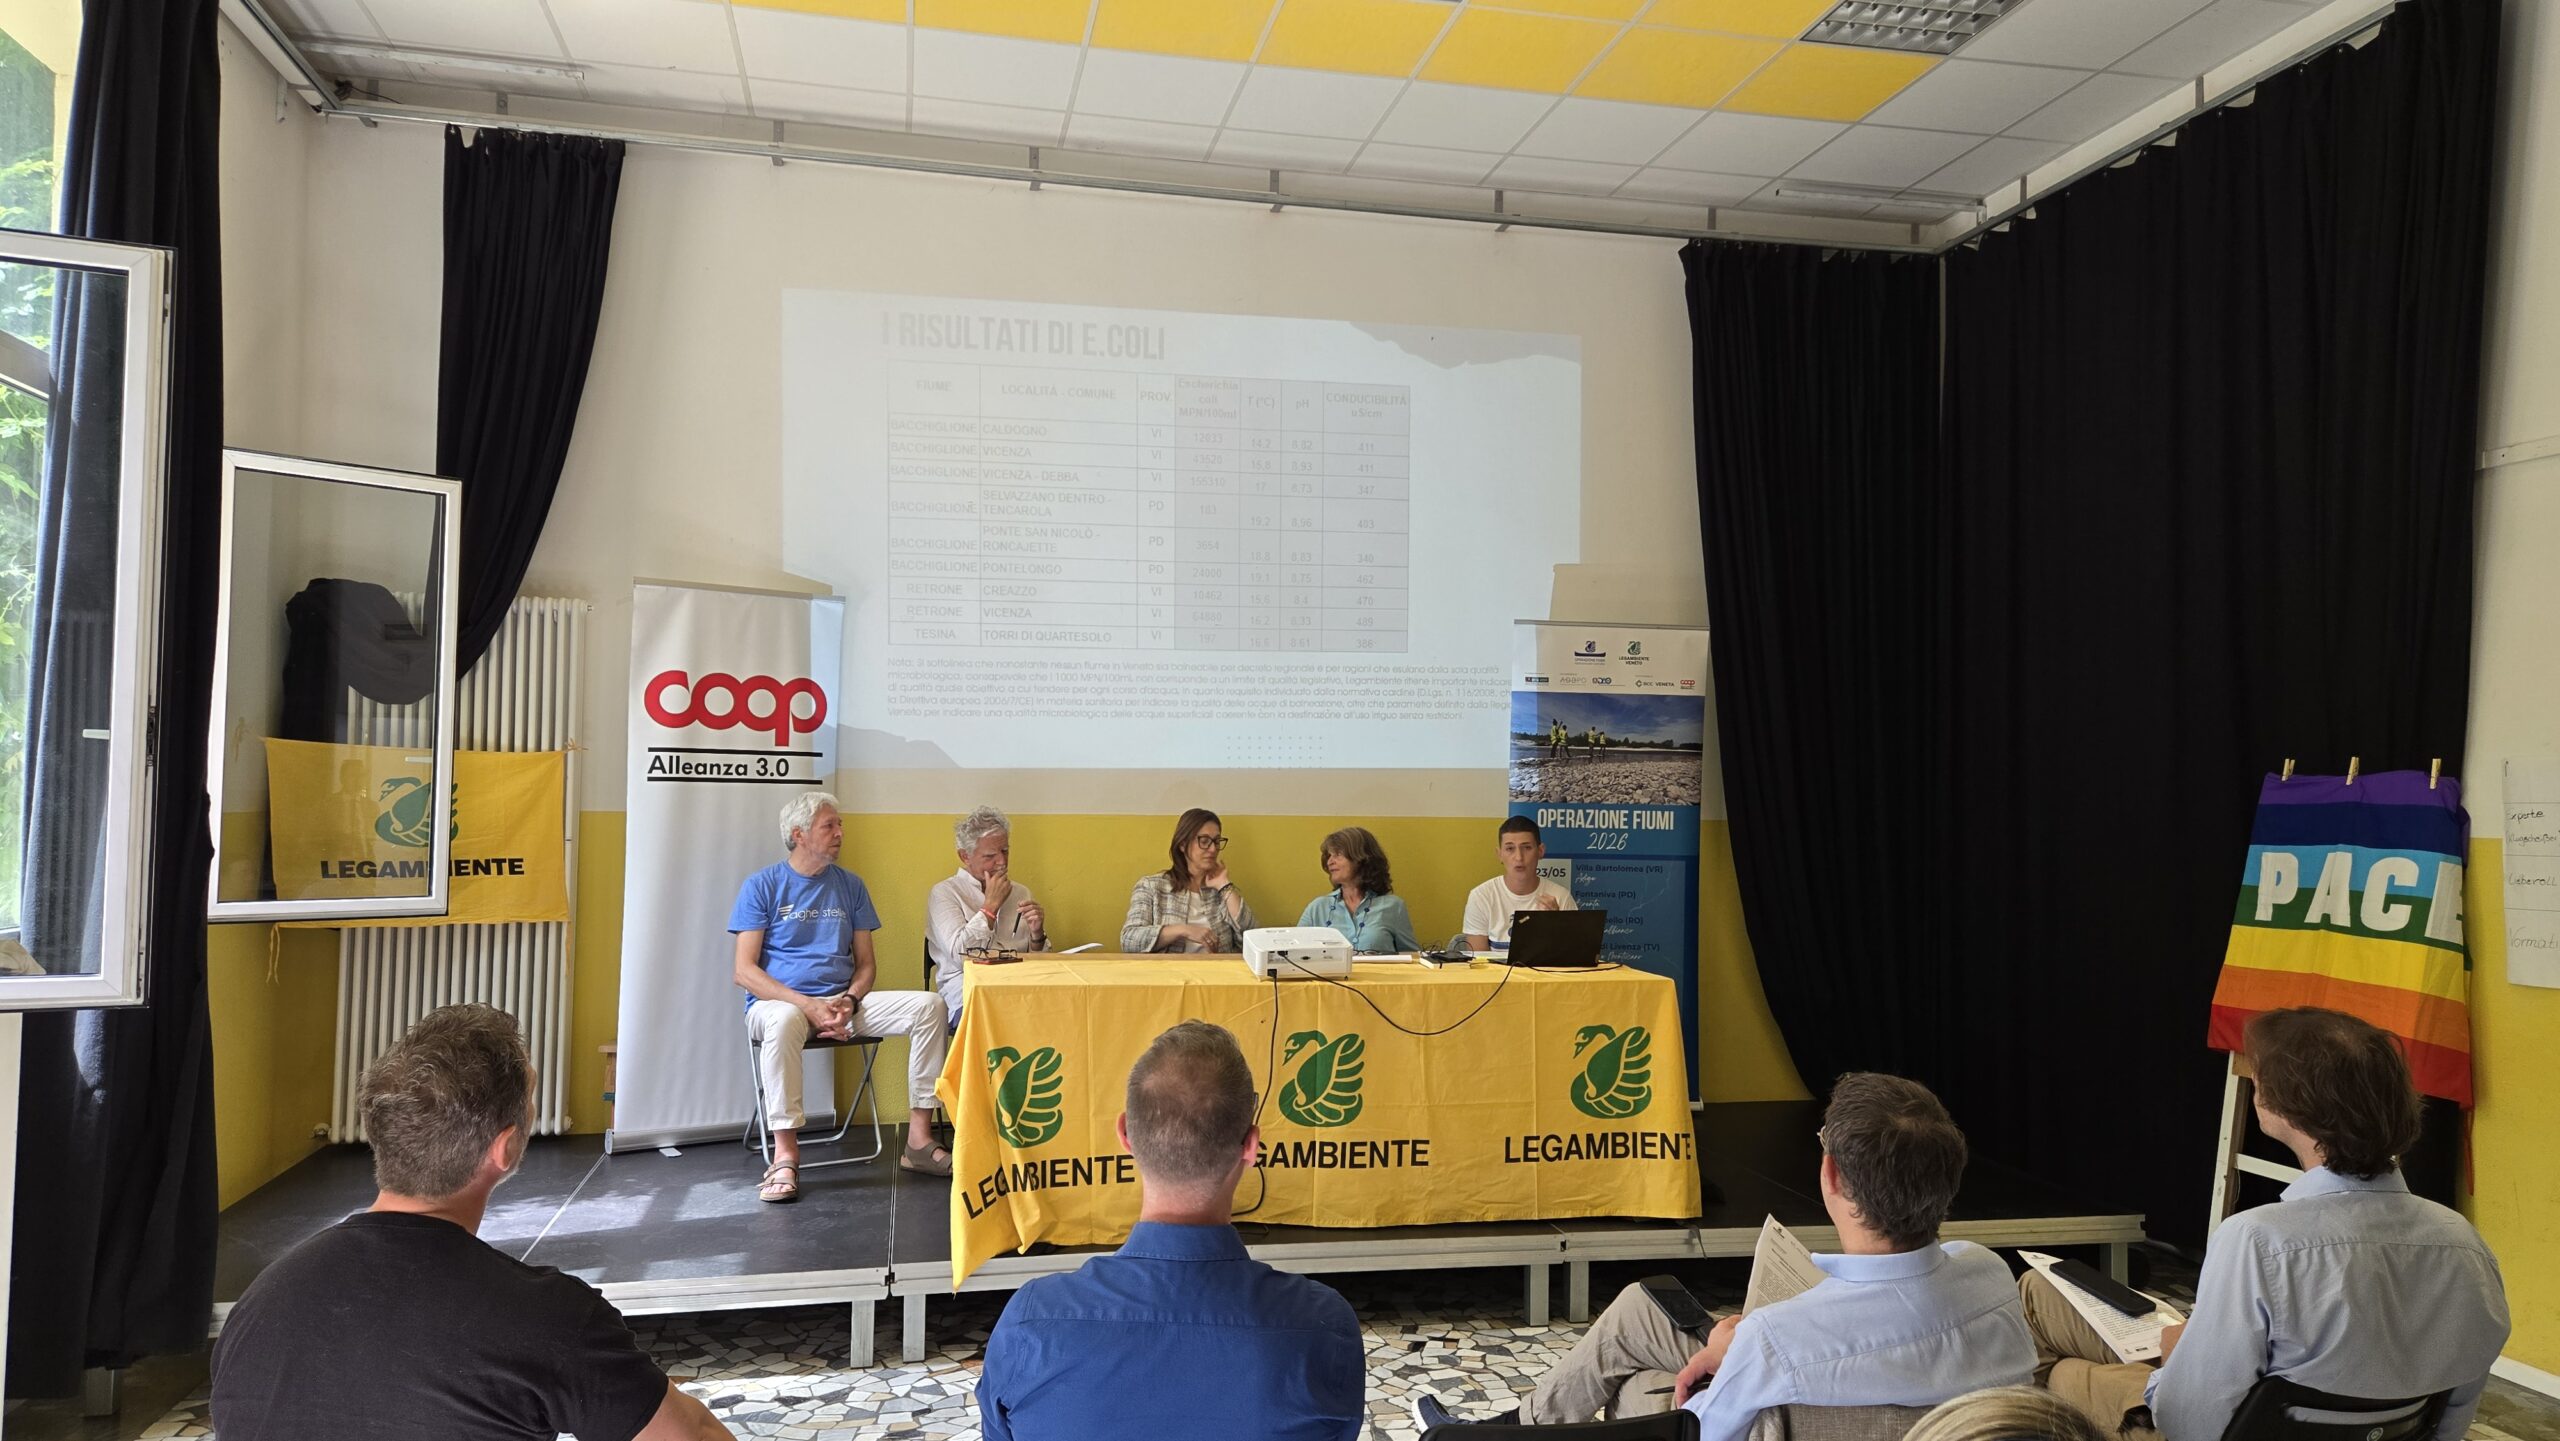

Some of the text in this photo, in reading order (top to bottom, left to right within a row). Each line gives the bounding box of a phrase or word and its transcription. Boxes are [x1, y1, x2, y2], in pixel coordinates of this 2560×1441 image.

[882, 311, 1165, 360] I RISULTATI DI E.COLI
[916, 379, 953, 392] FIUME
[1068, 387, 1117, 401] COMUNE
[1140, 391, 1174, 402] PROV.
[1296, 400, 1310, 411] pH
[890, 420, 977, 434] BACCHIGLIONE
[983, 424, 1048, 437] CALDOGNO
[1151, 428, 1162, 439] VI
[890, 442, 977, 456] BACCHIGLIONE
[983, 446, 1032, 458] VICENZA
[1151, 449, 1162, 460] VI
[890, 465, 977, 479] BACCHIGLIONE
[983, 469, 1032, 480] VICENZA
[1042, 471, 1080, 482] DEBBA
[1151, 471, 1162, 482] VI
[983, 490, 1105, 505] SELVAZZANO DENTRO
[890, 501, 977, 514] BACCHIGLIONE
[983, 504, 1052, 517] TENCAROLA
[1148, 500, 1164, 511] PD
[983, 525, 1022, 537] PONTE
[1025, 527, 1048, 538] SAN
[890, 537, 977, 550] BACCHIGLIONE
[983, 541, 1057, 553] RONCAJETTE
[1148, 536, 1164, 547] PD
[890, 560, 977, 572] BACCHIGLIONE
[983, 563, 1062, 575] PONTELONGO
[1148, 565, 1164, 575] PD
[906, 584, 963, 595] RETRONE
[983, 585, 1037, 597] CREAZZO
[1151, 586, 1162, 597] VI
[906, 606, 963, 617] RETRONE
[983, 608, 1032, 619] VICENZA
[1151, 608, 1162, 618] VI
[914, 628, 956, 640] TESINA
[984, 631, 1019, 641] TORRI
[1021, 631, 1032, 641] DI
[1035, 631, 1112, 643] QUARTESOLO
[1151, 630, 1162, 640] VI
[648, 755, 789, 777] Alleanza 3.0
[1537, 808, 1675, 831] OPERAZIONE FIUMI
[1586, 832, 1629, 850] 2026
[320, 858, 525, 879] LEGAMIENTE
[1535, 867, 1566, 879] 23/05
[1575, 864, 1663, 874] Villa Bartolomea (VR)
[1575, 891, 1636, 900] Fontaniva (PD)
[2254, 851, 2463, 945] PACE
[1252, 1139, 1430, 1169] GAMBIENTE
[961, 1154, 1135, 1220] LEGMBIENTE
